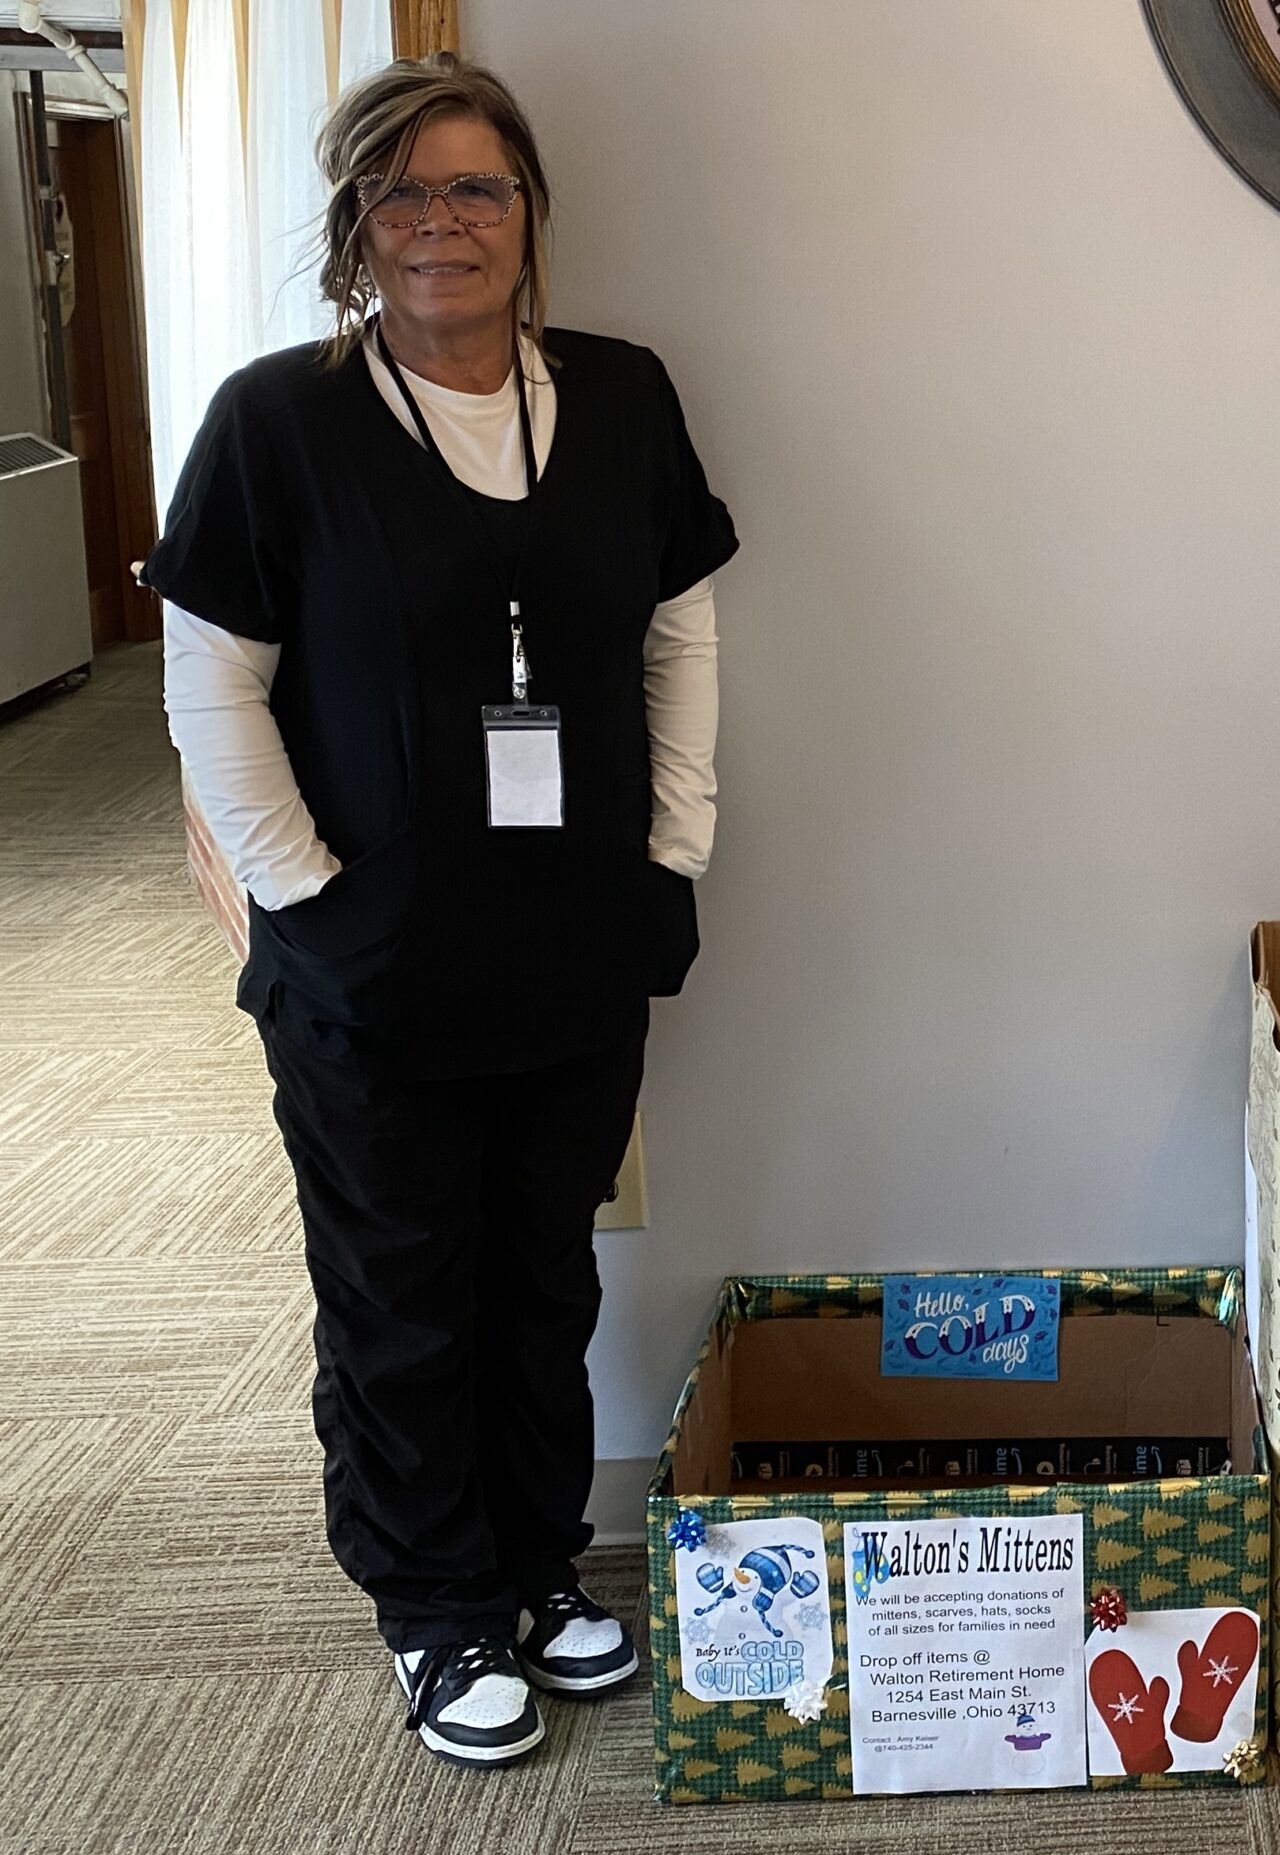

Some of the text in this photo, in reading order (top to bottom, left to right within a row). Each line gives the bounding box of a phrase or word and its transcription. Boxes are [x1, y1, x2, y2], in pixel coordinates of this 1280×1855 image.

[914, 1292, 969, 1318] Hello,
[903, 1294, 1036, 1360] COLD
[982, 1334, 1029, 1373] days
[861, 1527, 1074, 1580] Walton's Mittens
[856, 1588, 1064, 1606] We will be accepting donations of
[872, 1605, 1051, 1621] mittens, scarves, hats, socks
[868, 1619, 1055, 1636] of all sizes for families in need
[696, 1641, 804, 1662] Baby It's COLD
[860, 1650, 990, 1668] Drop off items @
[695, 1660, 804, 1696] OUTSIDE
[870, 1665, 1065, 1686] Walton Retirement Home
[886, 1685, 1031, 1703] 1254 East Main St.
[872, 1707, 956, 1722] Barnesville
[1007, 1701, 1055, 1716] 43713
